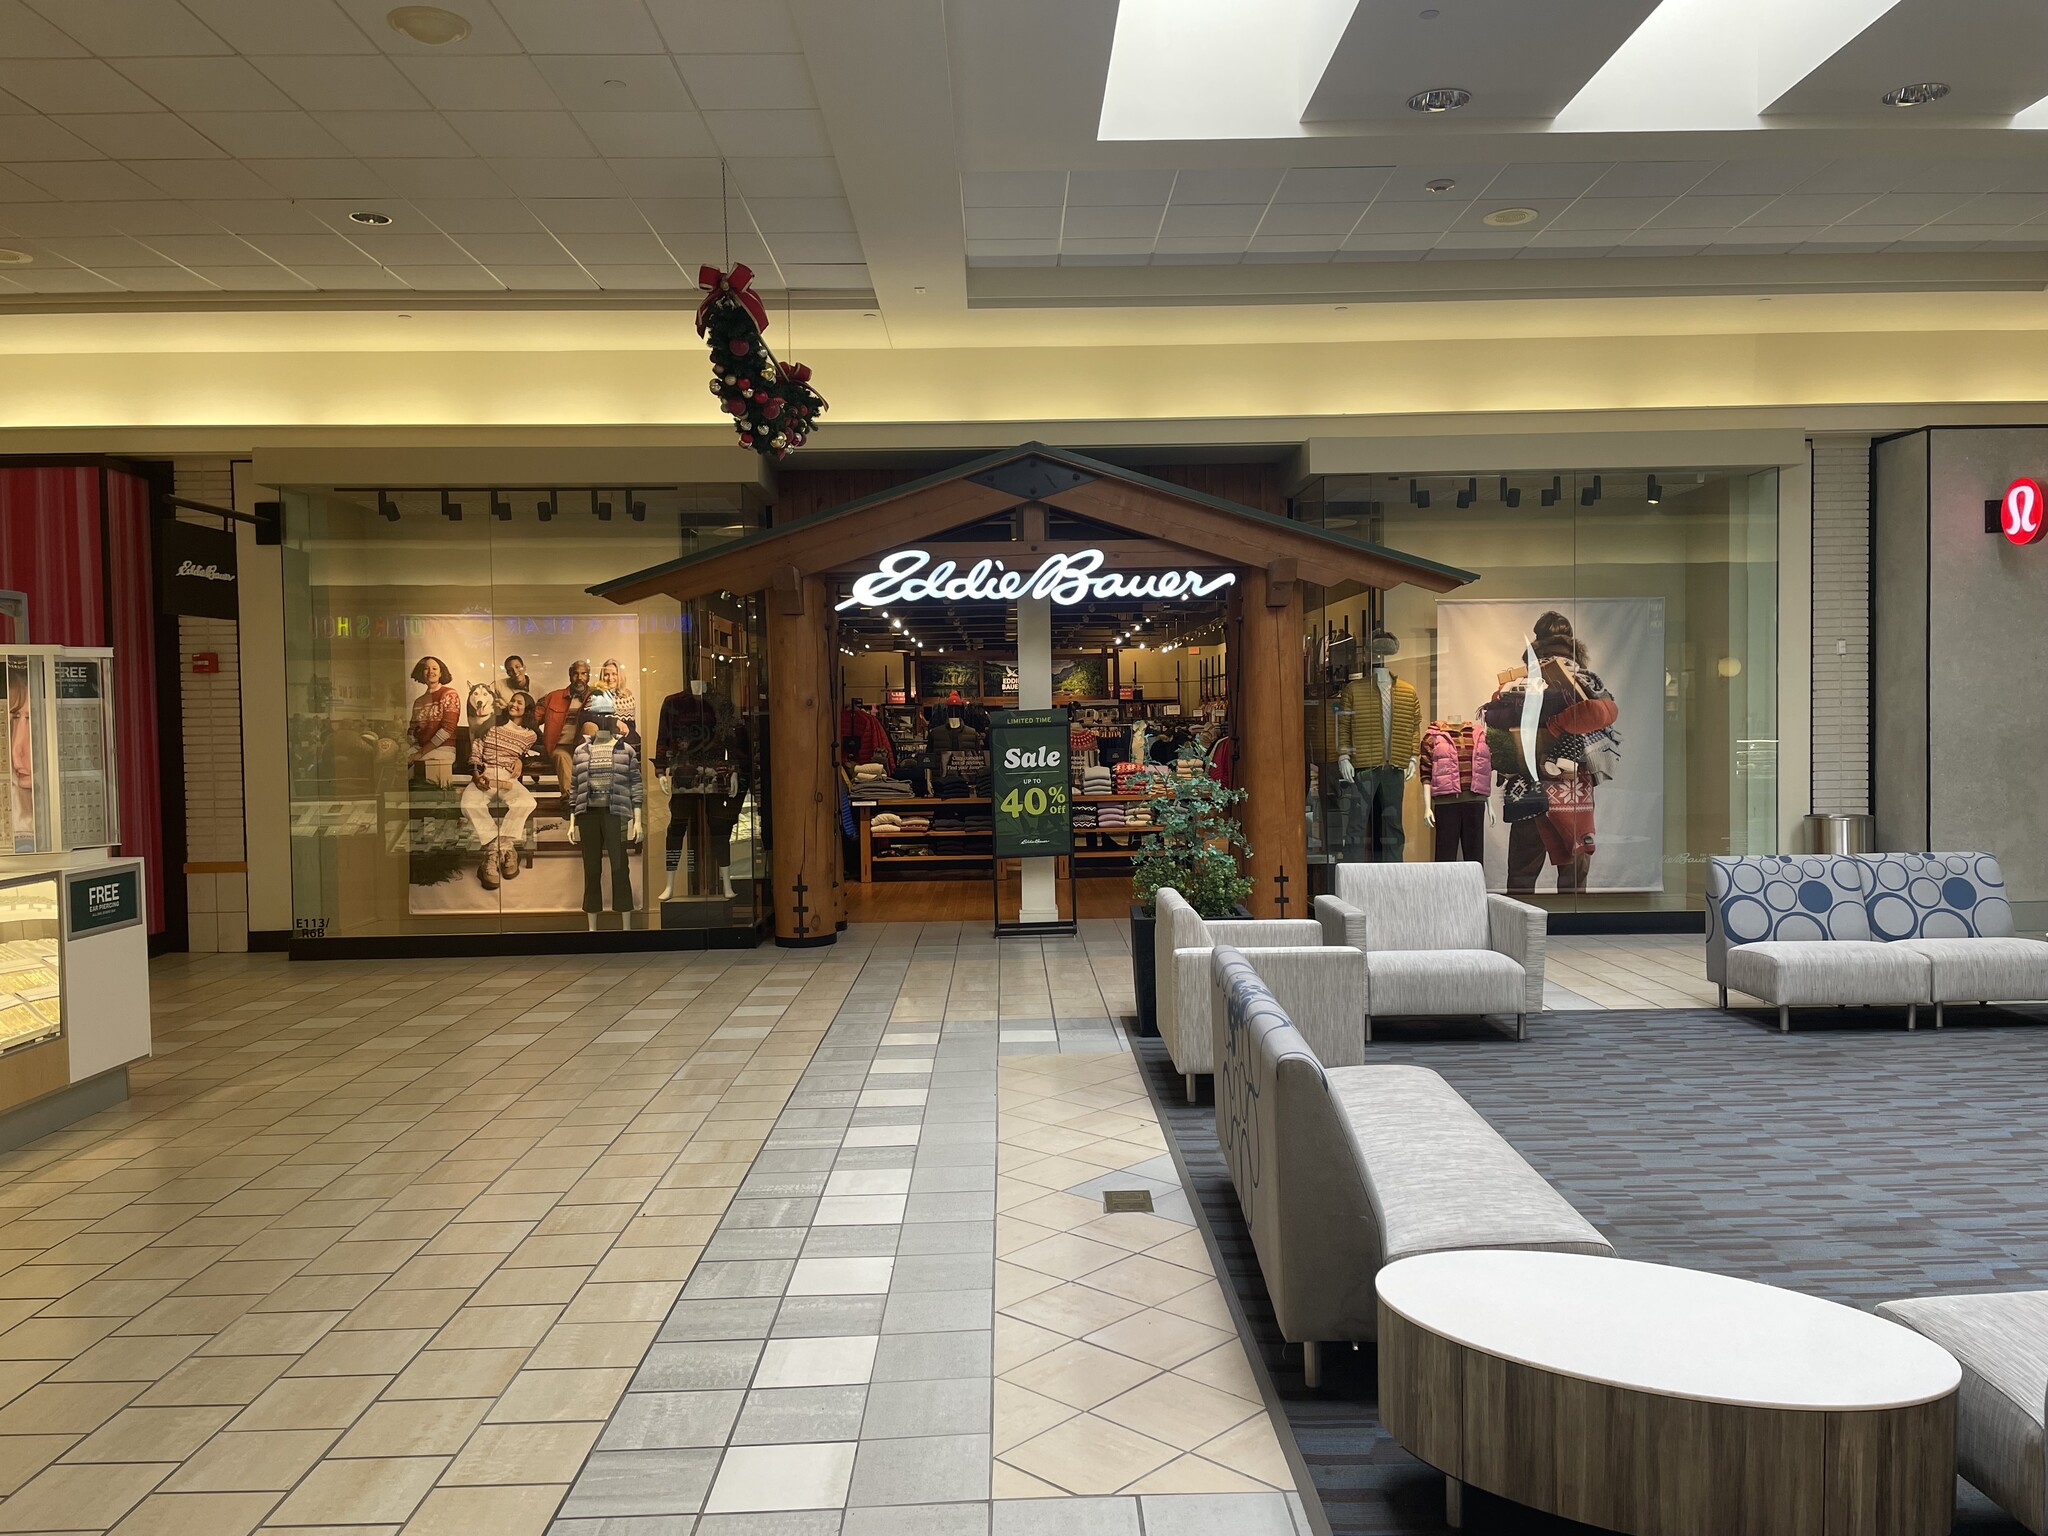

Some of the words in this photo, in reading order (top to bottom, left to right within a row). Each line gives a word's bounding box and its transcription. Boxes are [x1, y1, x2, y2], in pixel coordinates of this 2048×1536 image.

[175, 560, 206, 577] Eddie
[834, 549, 1032, 612] Eddie
[1031, 548, 1236, 607] Bauer
[1006, 717, 1034, 725] LIMITED
[1003, 745, 1061, 769] Sale
[1000, 786, 1066, 819] 40%
[1673, 852, 1708, 865] Baue
[88, 882, 121, 906] FREE
[89, 904, 99, 913] EAR
[98, 901, 120, 910] PIERCING
[296, 917, 330, 929] E113/
[302, 928, 325, 938] R6B
